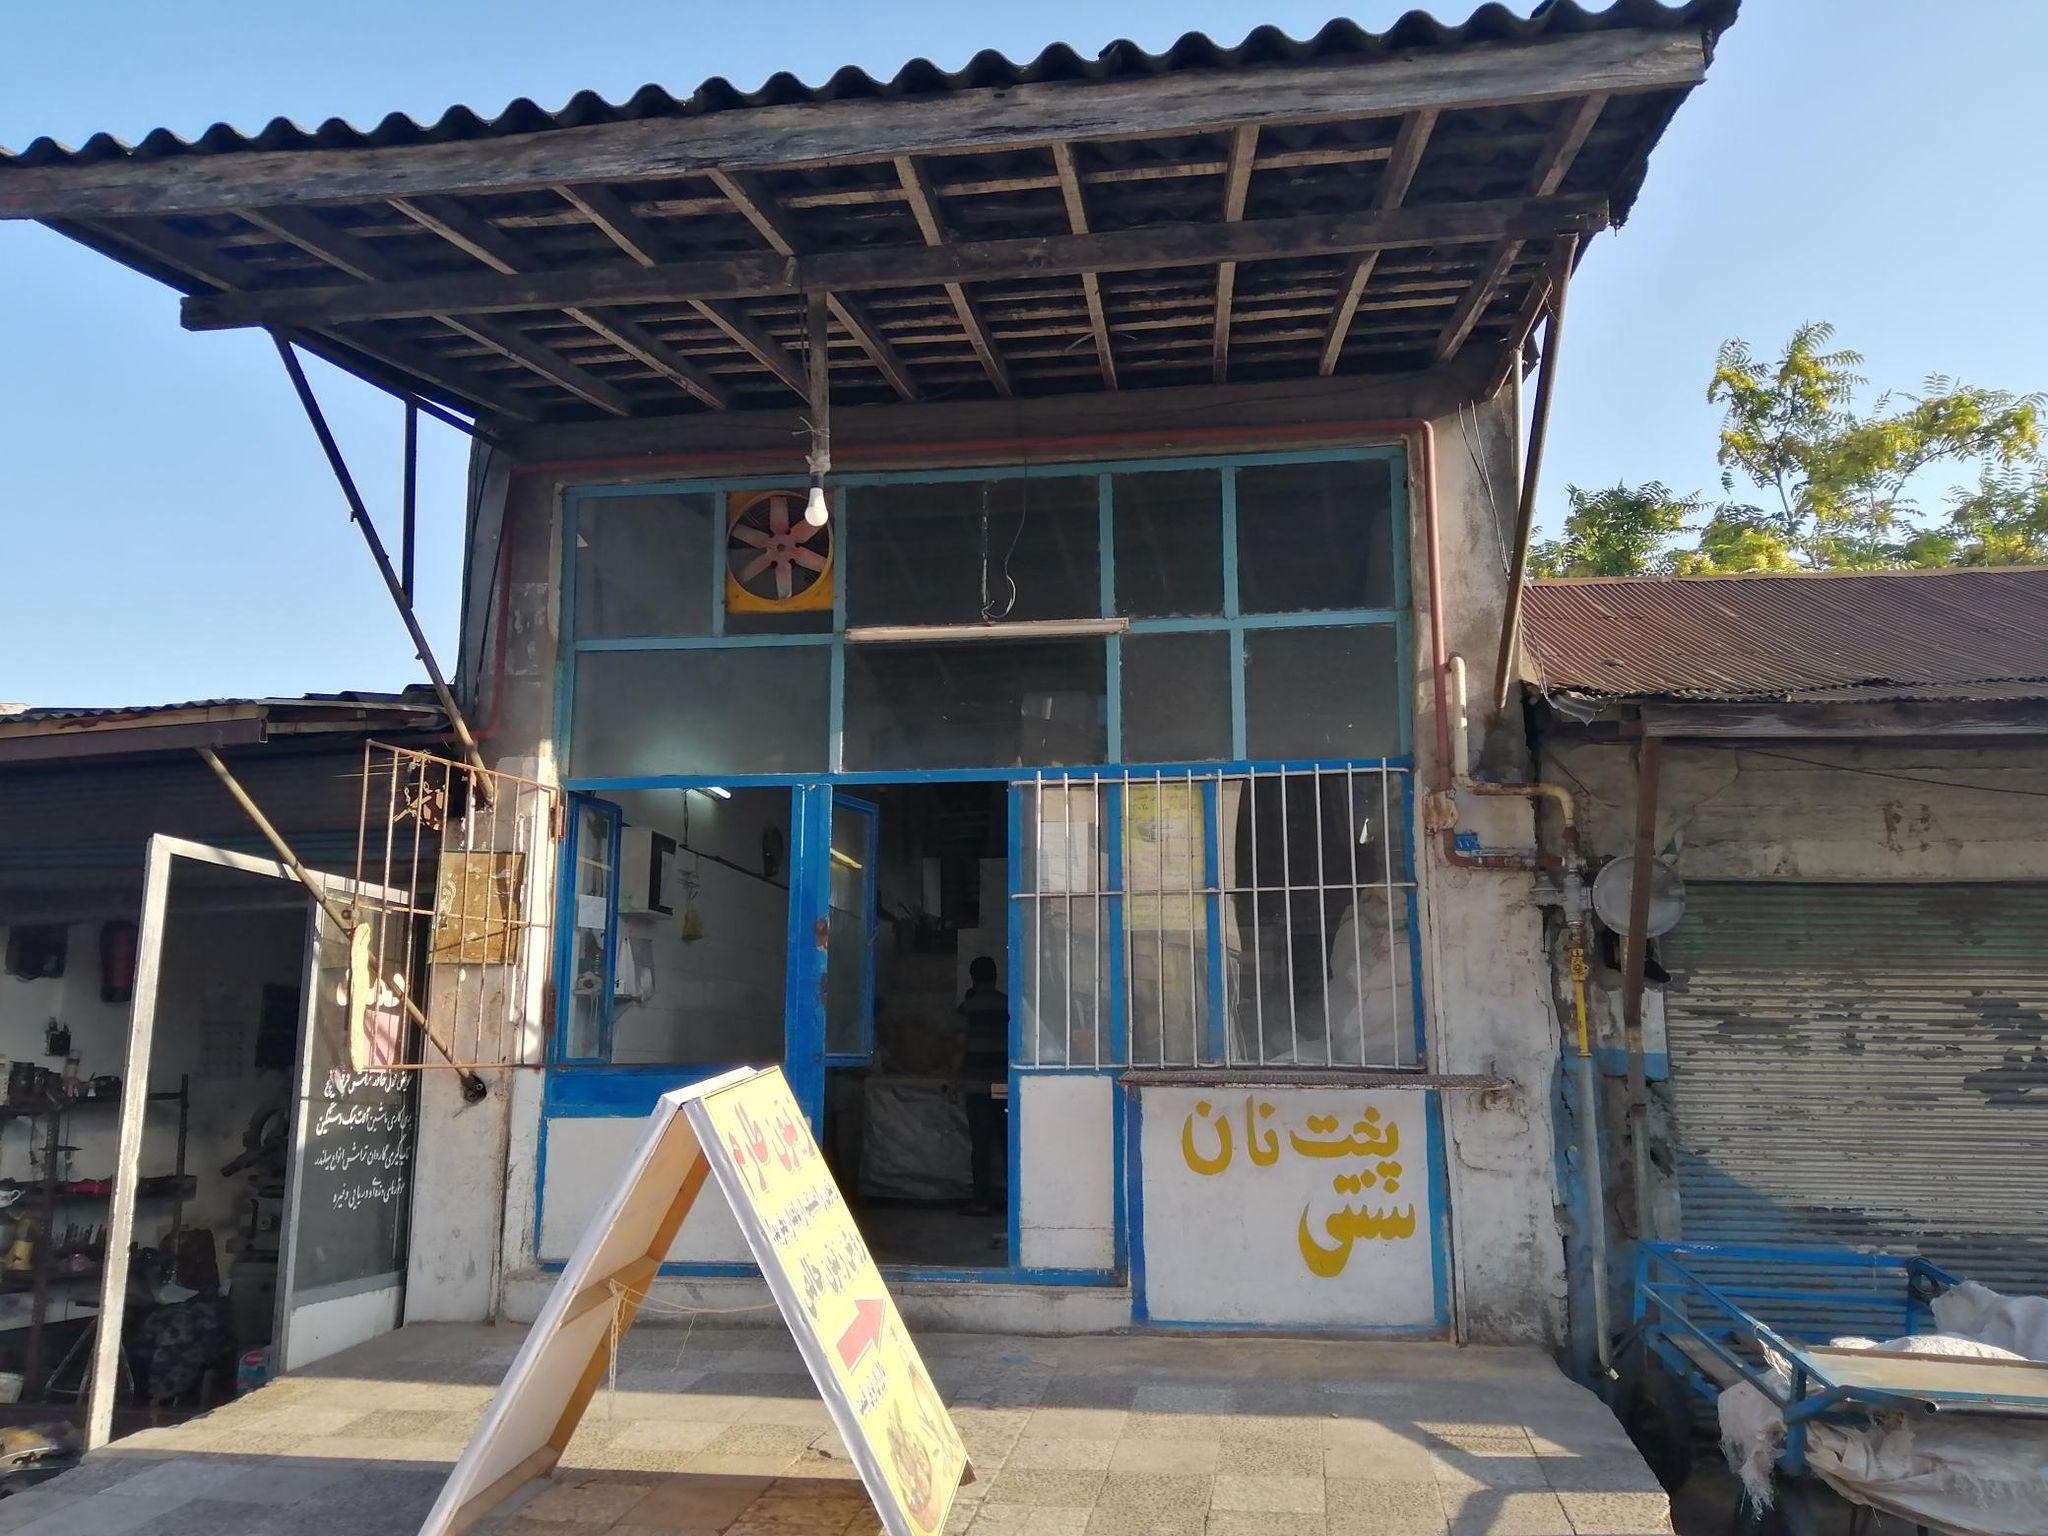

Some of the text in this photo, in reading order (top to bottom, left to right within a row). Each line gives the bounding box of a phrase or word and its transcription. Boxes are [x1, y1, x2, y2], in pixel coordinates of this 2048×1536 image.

[728, 1097, 817, 1200] زیتون طارم
[1181, 1093, 1403, 1194] پخت نان
[800, 1228, 867, 1320] روغن زیتون خالص
[1298, 1168, 1417, 1278] سنتی
